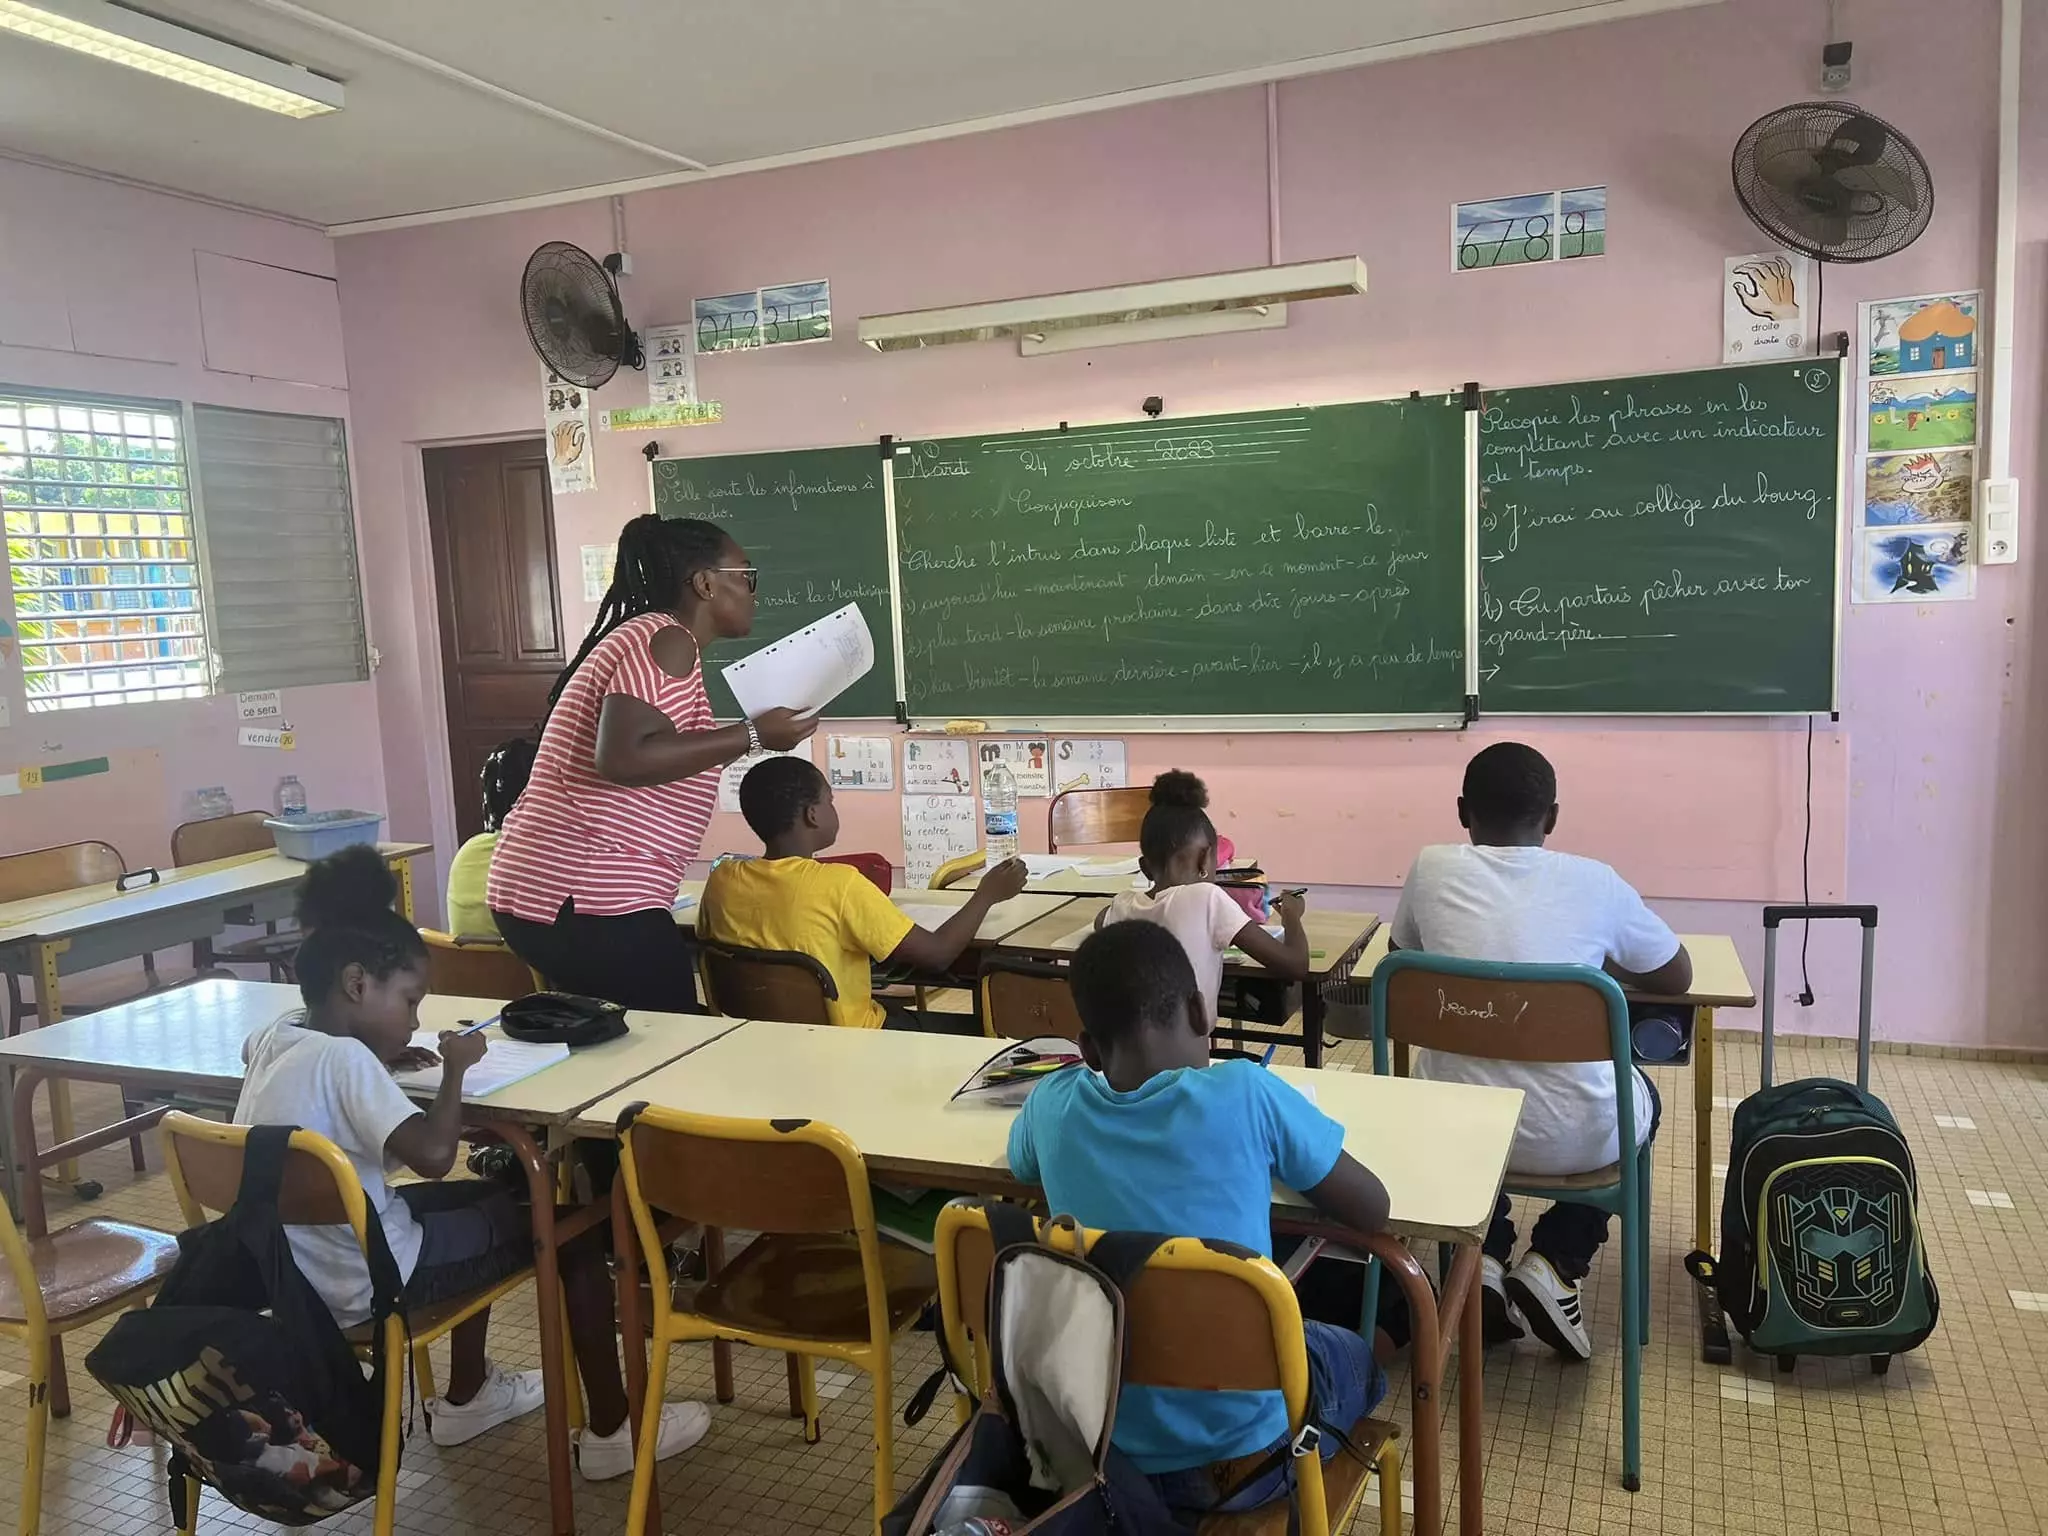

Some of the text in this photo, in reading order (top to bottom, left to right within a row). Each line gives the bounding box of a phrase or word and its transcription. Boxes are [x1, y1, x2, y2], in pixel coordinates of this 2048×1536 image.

[1752, 322, 1780, 332] droite
[1754, 335, 1780, 345] droite
[1481, 383, 1768, 441] Recopie les phrases en les
[911, 439, 1215, 478] Mardi 24 octobre 2023
[1483, 414, 1826, 468] complétant avec un indicateur
[668, 479, 701, 502] Elle
[747, 472, 767, 496] les
[774, 469, 858, 512] informations
[862, 473, 875, 490] à
[1483, 457, 1593, 486] de temps.
[1008, 489, 1132, 526] Conjugaison
[1481, 470, 1832, 552] a) J'irai au collège du bourg.
[906, 545, 977, 571] Cherche
[988, 540, 1062, 566] l'intrus
[1070, 538, 1121, 561] dans
[1127, 524, 1193, 564] chaque
[1199, 520, 1238, 548] liste
[1254, 524, 1281, 545] et
[1037, 571, 1128, 594] maintenant
[1145, 563, 1206, 590] demain
[1224, 568, 1253, 580] en
[1283, 555, 1343, 575] moment
[1387, 544, 1429, 577] jour
[805, 580, 826, 603] la
[1481, 566, 1811, 624] b) Tu partais pêcher avec ton
[922, 621, 958, 666] plus
[965, 621, 1002, 643] tard
[1016, 612, 1032, 639] la
[1037, 618, 1097, 638] semaine
[1103, 595, 1180, 642] prochaine
[1195, 593, 1242, 620] dans
[1249, 588, 1281, 612] dix
[1289, 588, 1336, 619] jours
[1352, 579, 1411, 613] après
[1051, 671, 1108, 688] semaine
[1111, 658, 1177, 686] dernière
[1369, 652, 1400, 681] peu
[1404, 641, 1424, 664] de
[1427, 636, 1464, 673] temps
[243, 706, 277, 717] ce sera
[940, 812, 952, 821] un
[918, 842, 933, 852] rue
